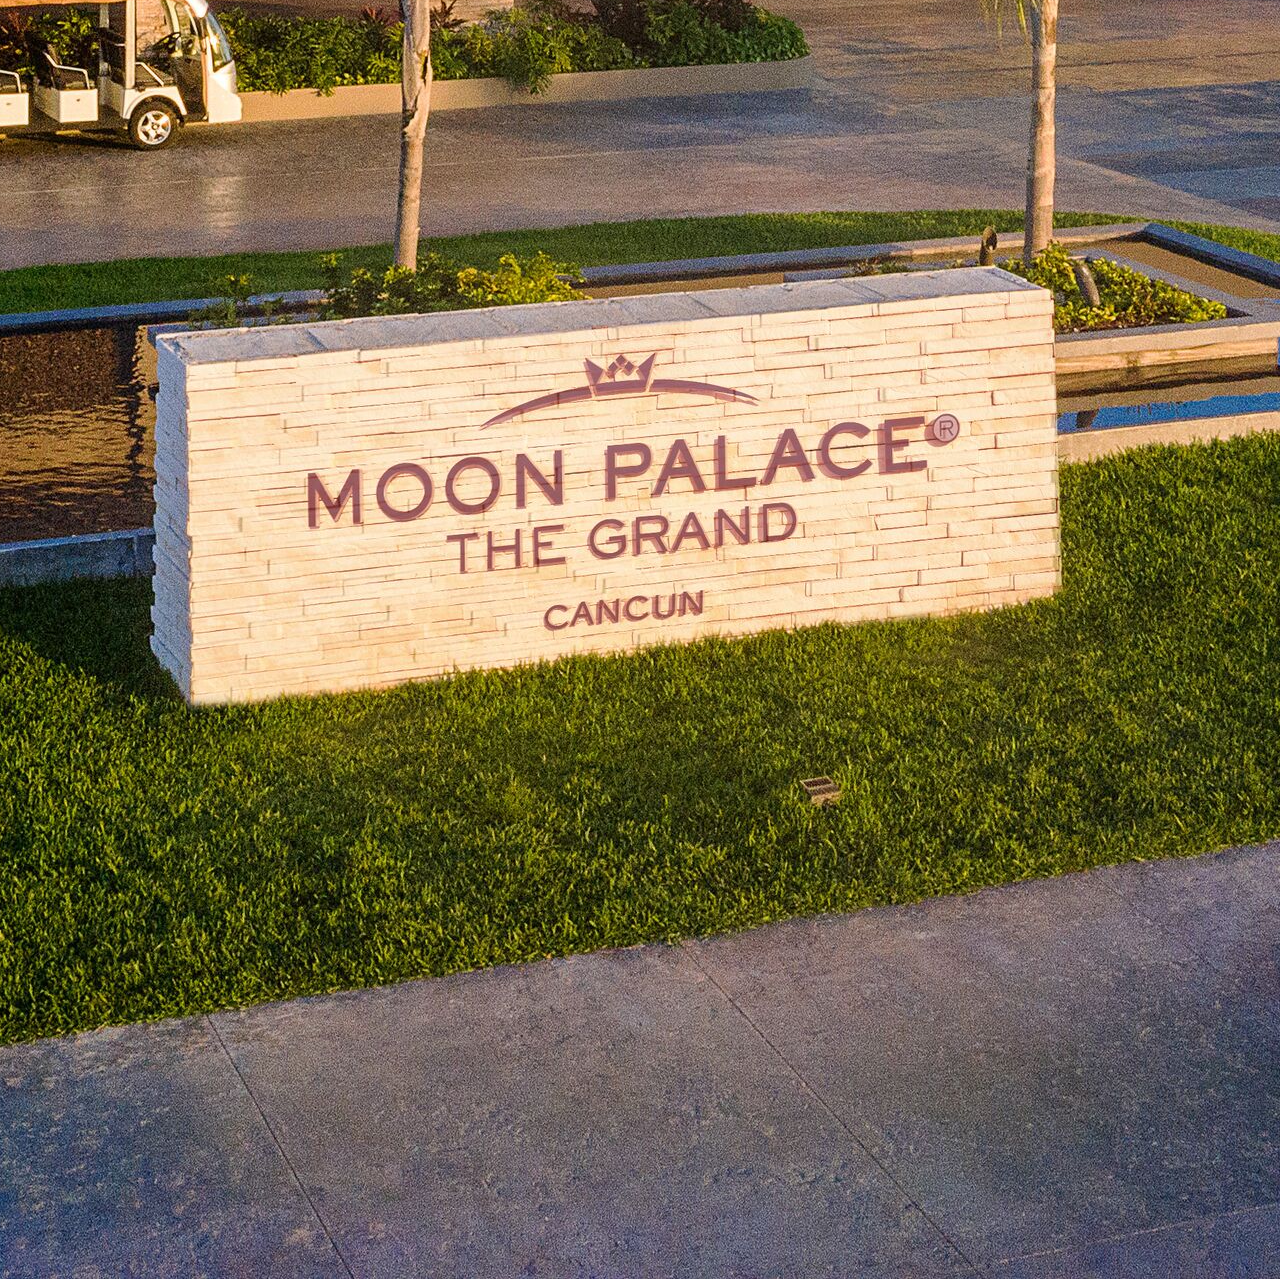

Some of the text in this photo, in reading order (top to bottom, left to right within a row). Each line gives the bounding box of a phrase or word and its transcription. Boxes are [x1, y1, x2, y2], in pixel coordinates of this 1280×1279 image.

[306, 448, 565, 529] MOON
[446, 501, 799, 575] THE GRAND
[543, 589, 705, 631] CANCUN
